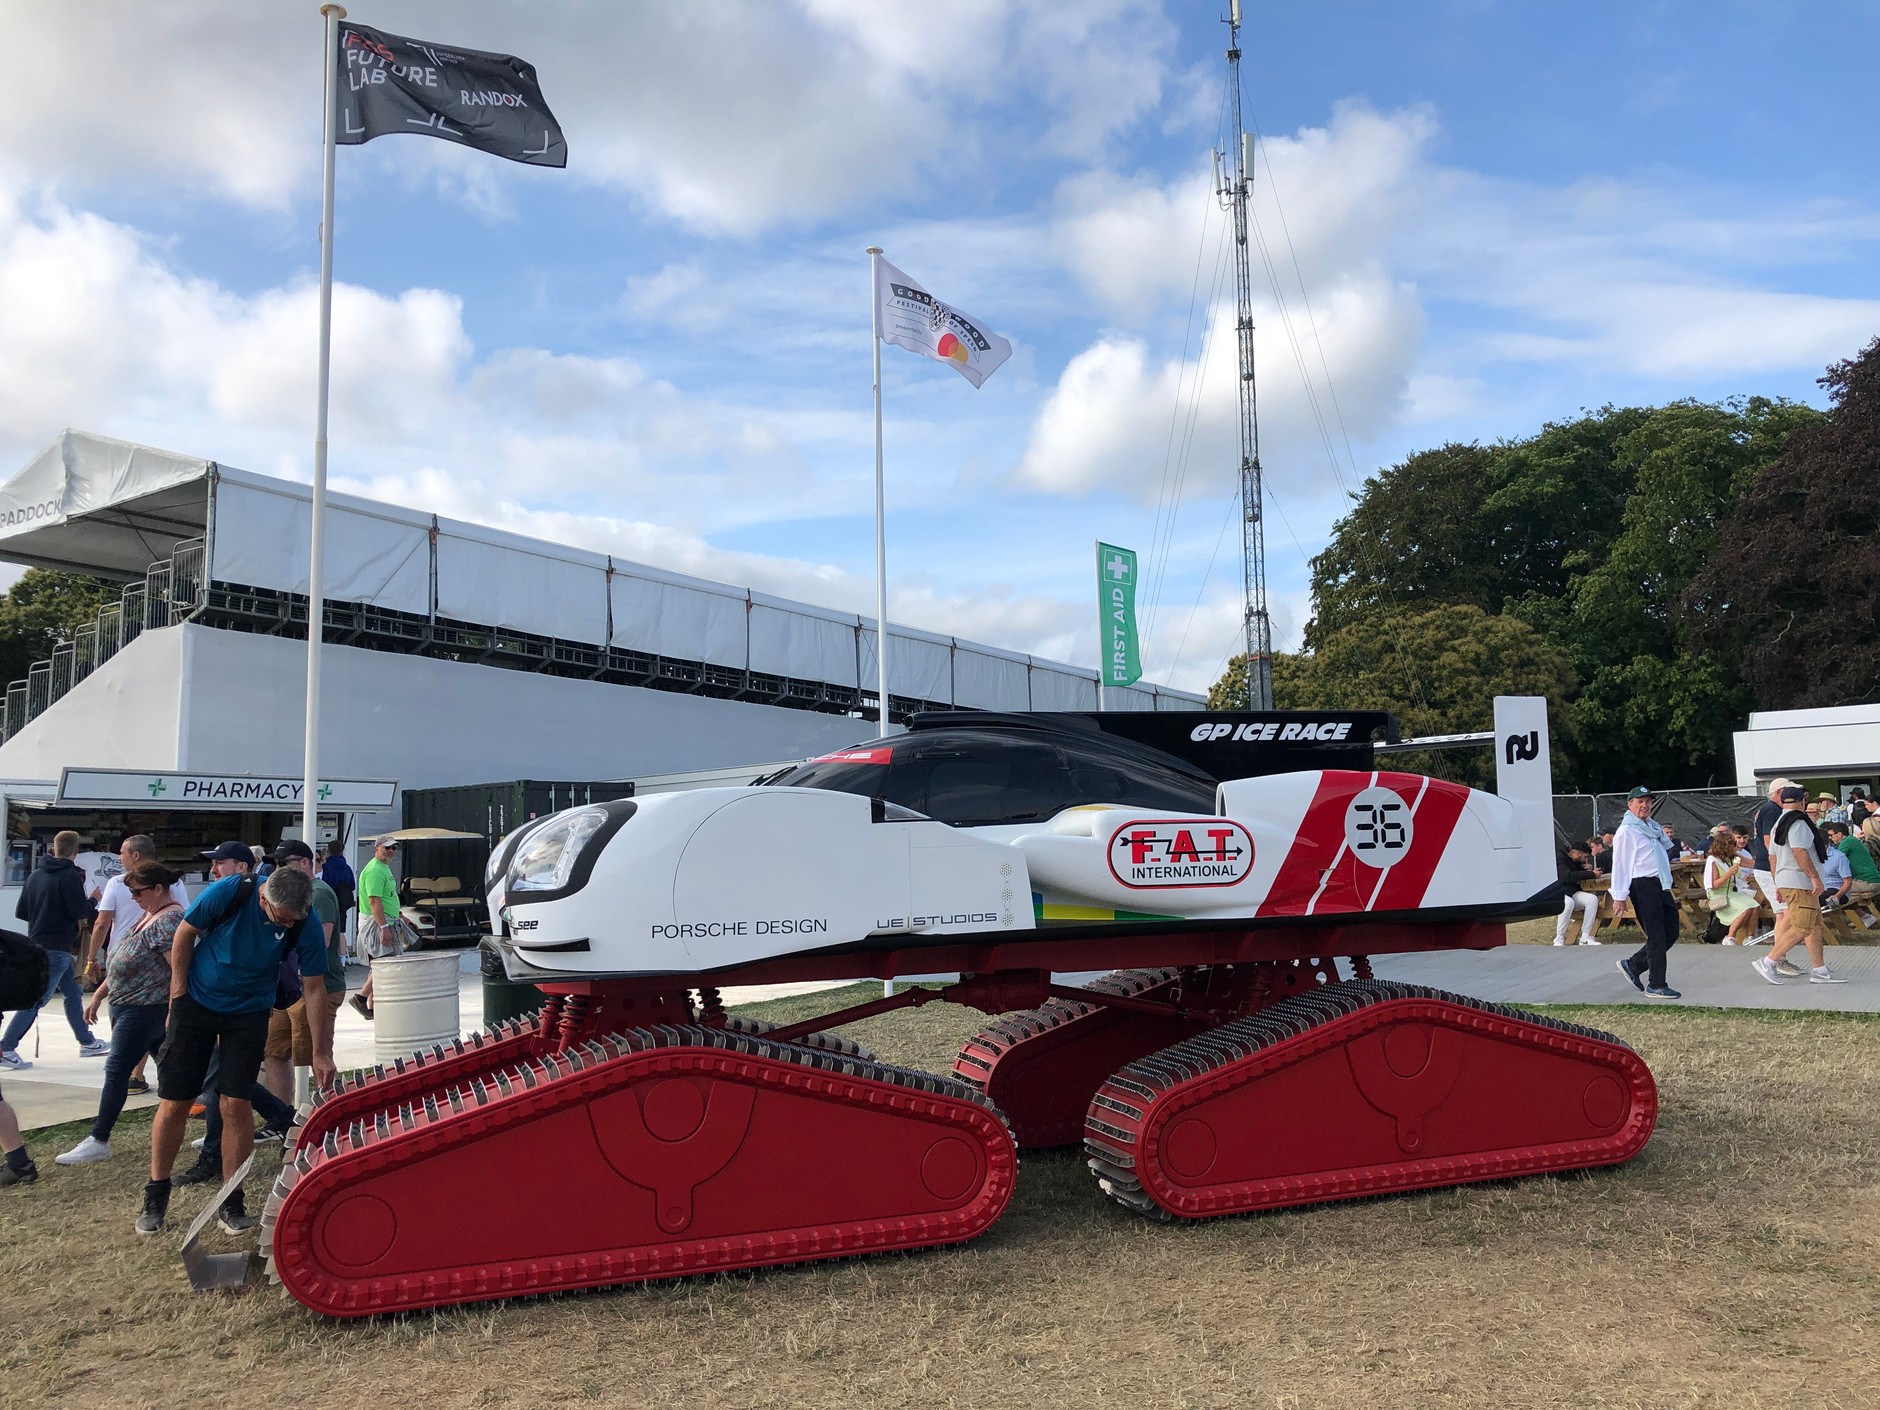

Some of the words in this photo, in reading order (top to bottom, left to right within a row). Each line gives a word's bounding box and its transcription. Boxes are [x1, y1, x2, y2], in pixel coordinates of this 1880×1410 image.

[346, 49, 438, 87] FUTURE
[348, 67, 388, 91] LAB
[461, 90, 527, 107] RANDOX
[896, 300, 930, 315] FESTIVAL
[949, 320, 959, 329] OF
[959, 330, 977, 352] SPEED
[0, 498, 61, 528] PADDOCK
[1112, 588, 1126, 624] AID
[1113, 626, 1128, 681] FIRST
[1190, 723, 1233, 742] GP
[1231, 722, 1280, 741] ICE
[1278, 722, 1353, 741] RACE
[183, 781, 305, 800] PHARMACY
[1354, 804, 1405, 849] 36
[1132, 865, 1238, 879] INTERNATIONAL
[651, 922, 748, 939] PORSCHE
[755, 919, 828, 935] DESIGN
[913, 912, 997, 926] STUDIOS
